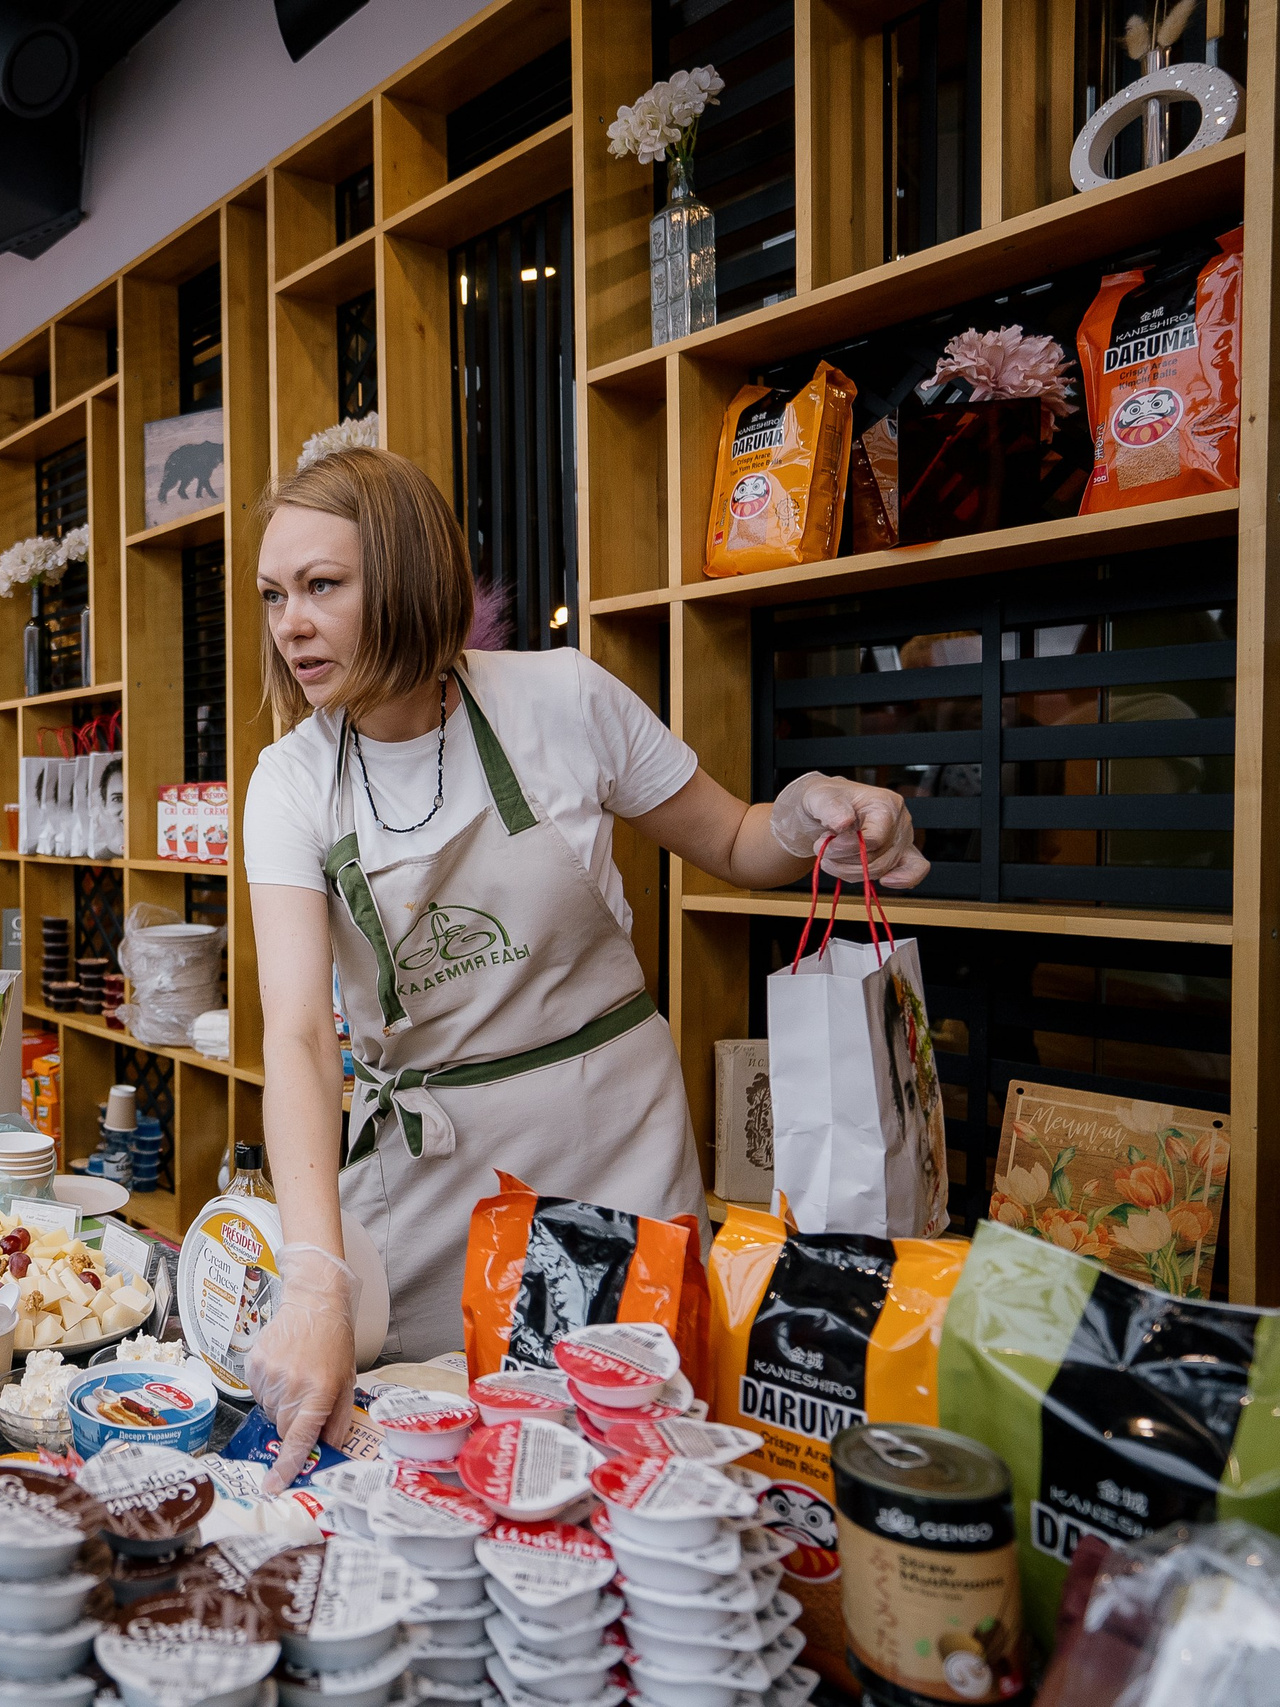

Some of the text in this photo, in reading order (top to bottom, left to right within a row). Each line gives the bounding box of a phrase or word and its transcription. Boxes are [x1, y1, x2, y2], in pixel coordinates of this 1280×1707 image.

[1116, 313, 1189, 342] KANESHIRO
[1105, 325, 1198, 373] DARUMA
[1119, 368, 1177, 391] Kimchi Balls
[1120, 365, 1149, 381] Crispy
[737, 418, 781, 436] KANESHIRO
[732, 429, 784, 459] DARUMA
[737, 455, 753, 466] Crispy
[738, 464, 751, 473] Yum
[752, 461, 764, 469] Rice
[397, 944, 531, 996] КАДЕМИЯ ЕДЫ
[1029, 1106, 1127, 1148] Мечтай
[221, 1223, 262, 1257] PRÉSIDENT
[203, 1247, 231, 1275] Cream
[208, 1266, 238, 1295] Cheese
[754, 1359, 857, 1400] KANESHIRO
[119, 1430, 182, 1442] Десерт Тирамису
[761, 1431, 831, 1464] Crispy Ara
[139, 1469, 187, 1491] соус
[769, 1451, 797, 1469] Yum
[800, 1461, 829, 1481] Rice
[106, 1483, 197, 1516] Соевый
